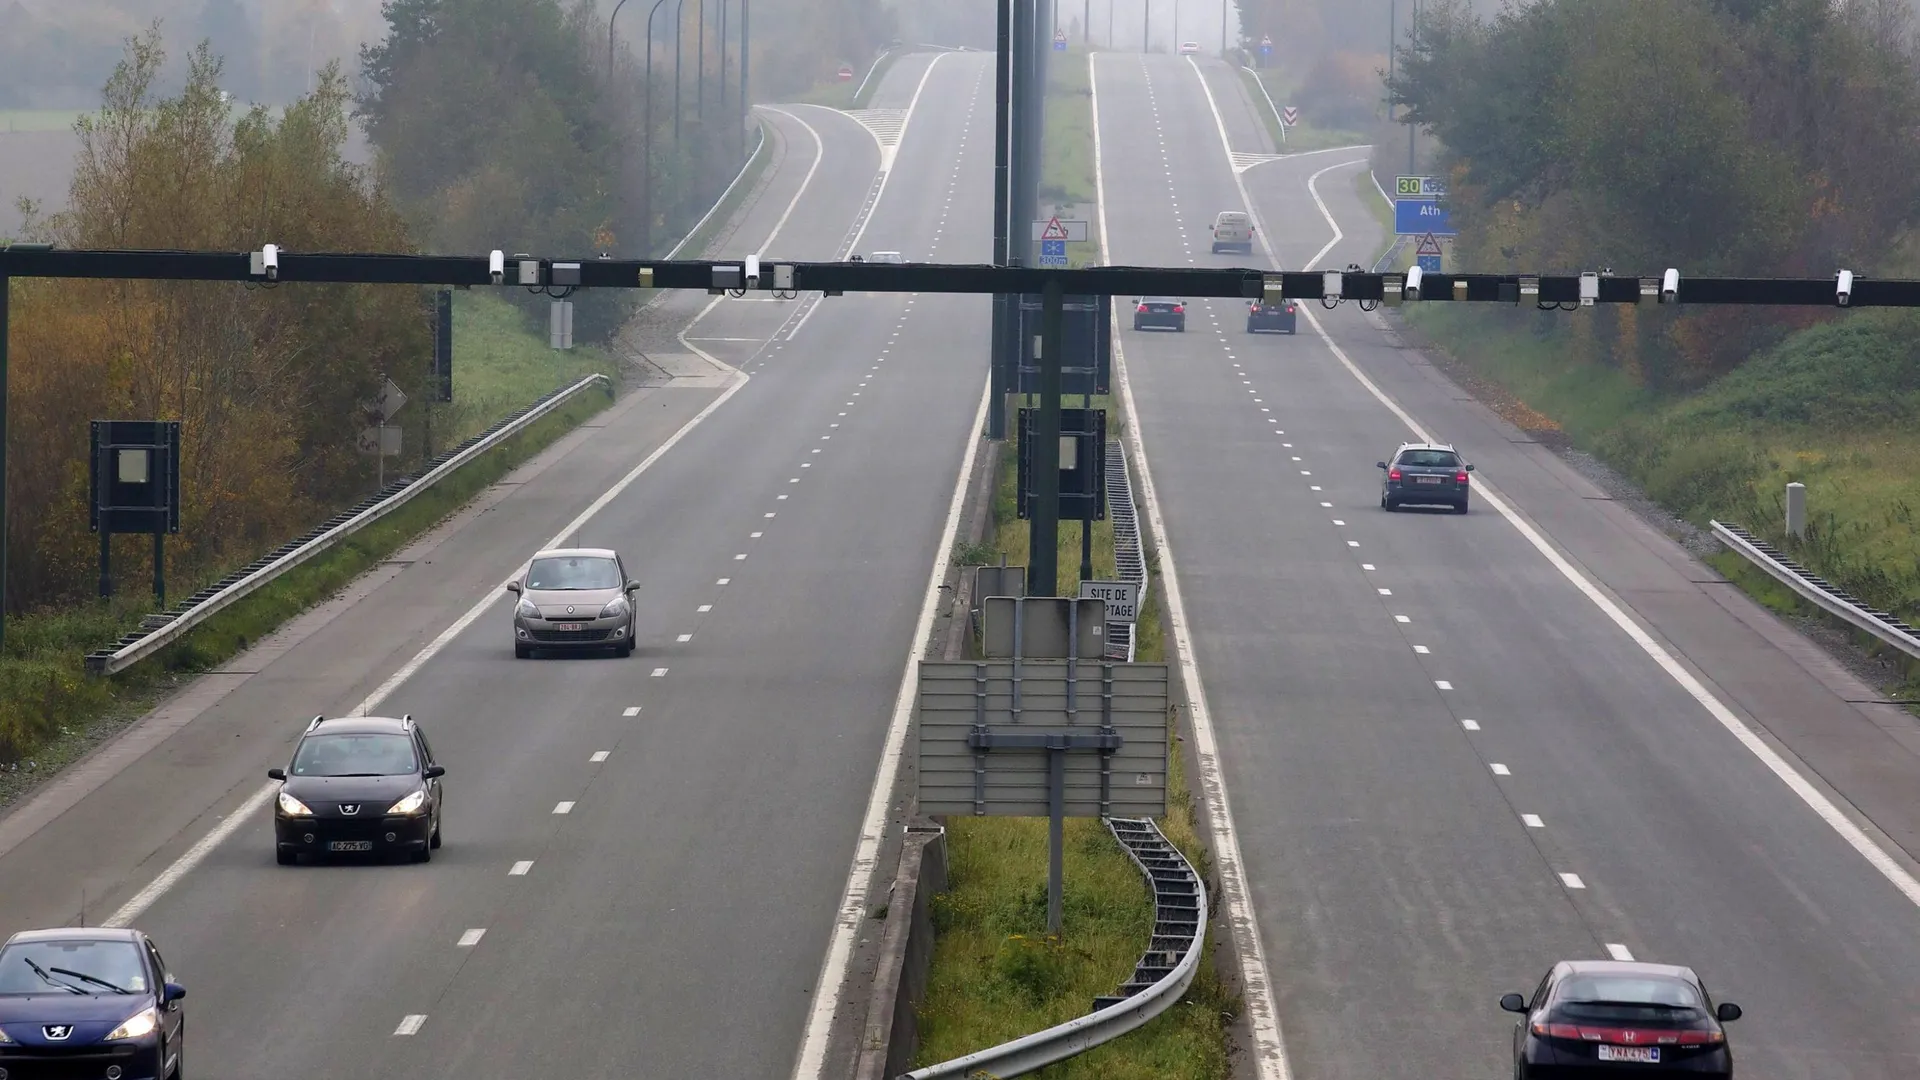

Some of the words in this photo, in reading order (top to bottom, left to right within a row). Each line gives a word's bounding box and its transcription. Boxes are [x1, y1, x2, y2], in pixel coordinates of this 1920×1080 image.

[1400, 180, 1419, 192] 30
[1420, 205, 1440, 216] Ath
[1091, 588, 1112, 600] SITE
[1115, 589, 1127, 601] DE
